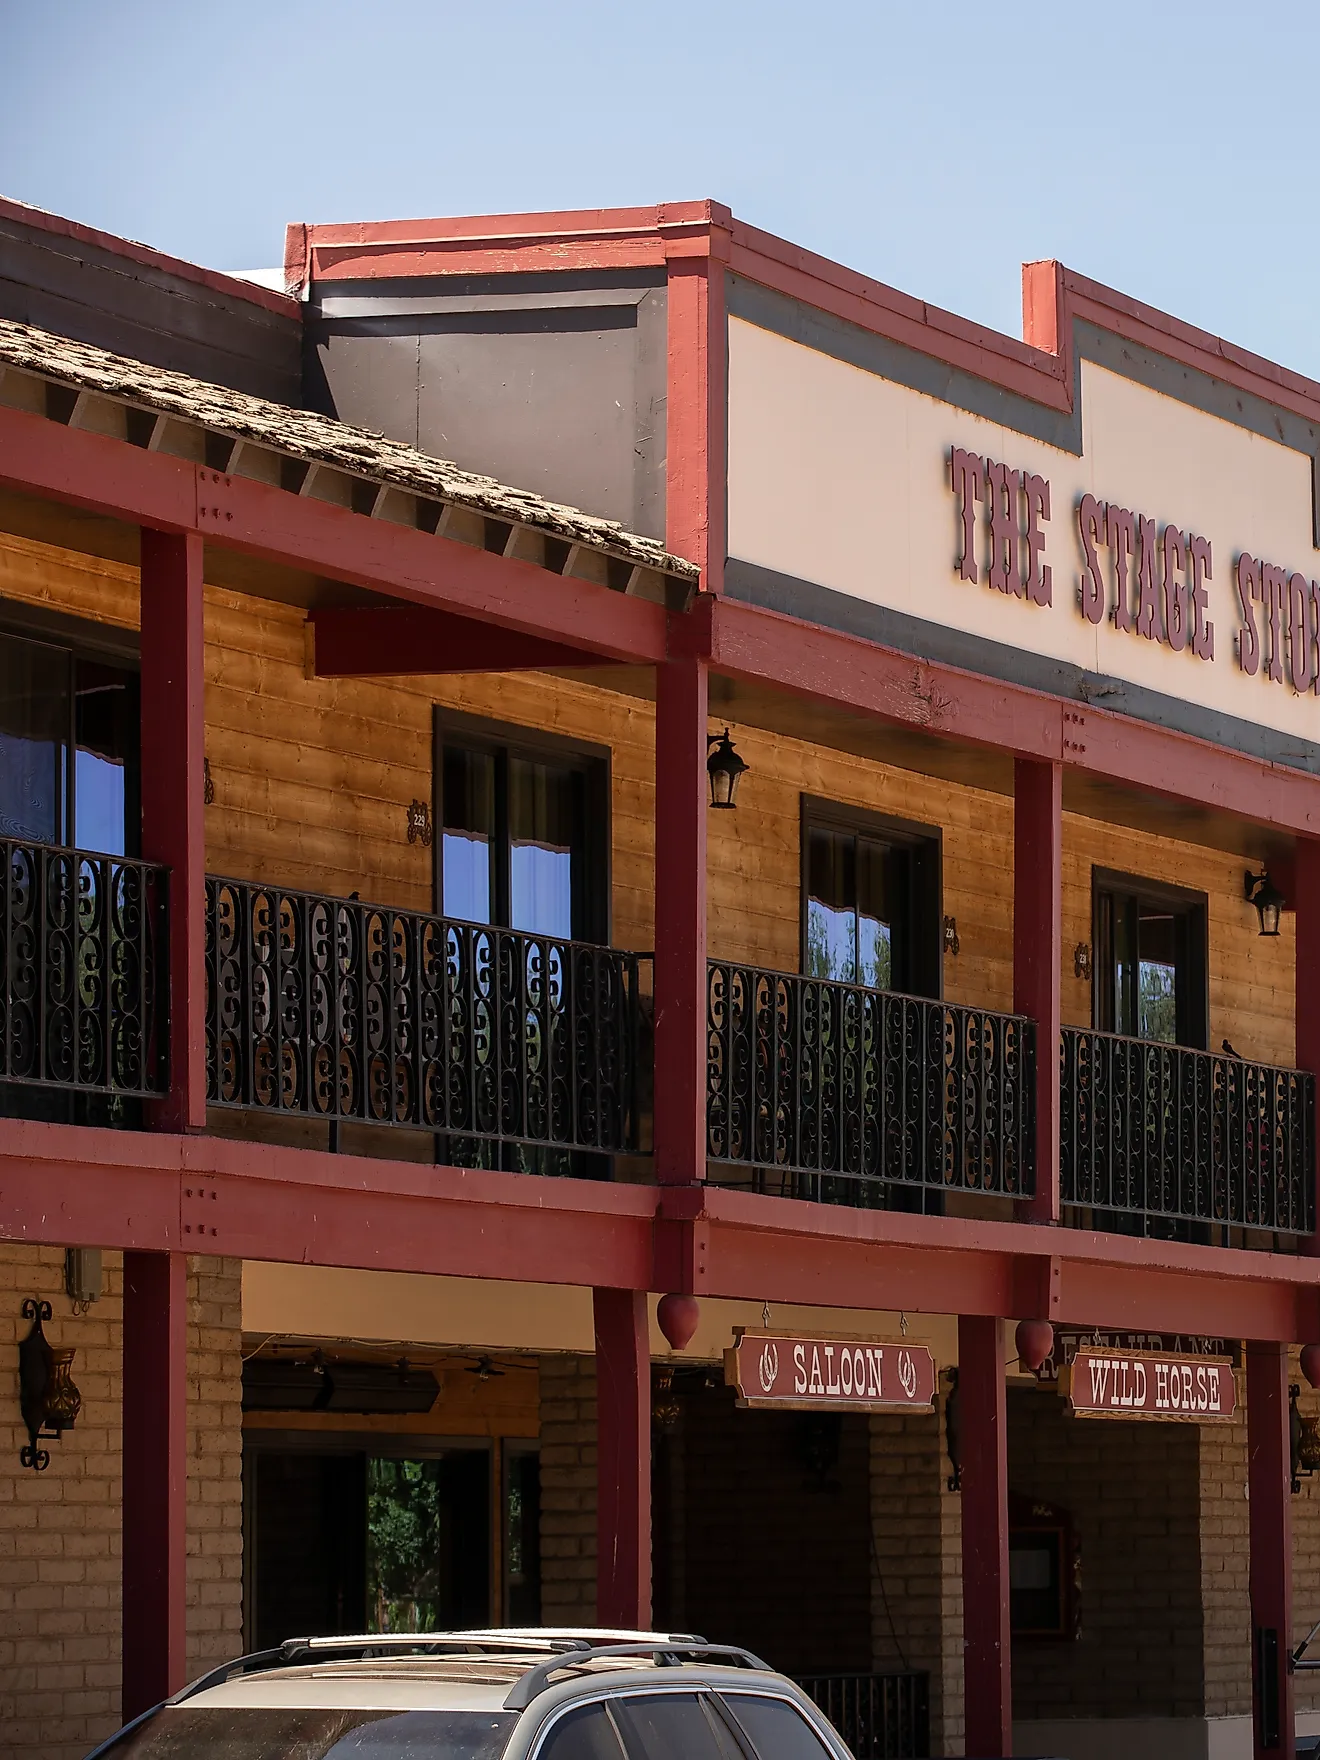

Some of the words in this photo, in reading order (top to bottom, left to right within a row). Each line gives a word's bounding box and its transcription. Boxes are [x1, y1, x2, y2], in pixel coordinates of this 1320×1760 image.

[949, 445, 1053, 609] THE
[1079, 492, 1215, 663] STAGE
[414, 813, 425, 827] 229
[794, 1344, 883, 1397] SALOON
[1088, 1359, 1147, 1407] WILD
[1155, 1363, 1221, 1411] HORSE
